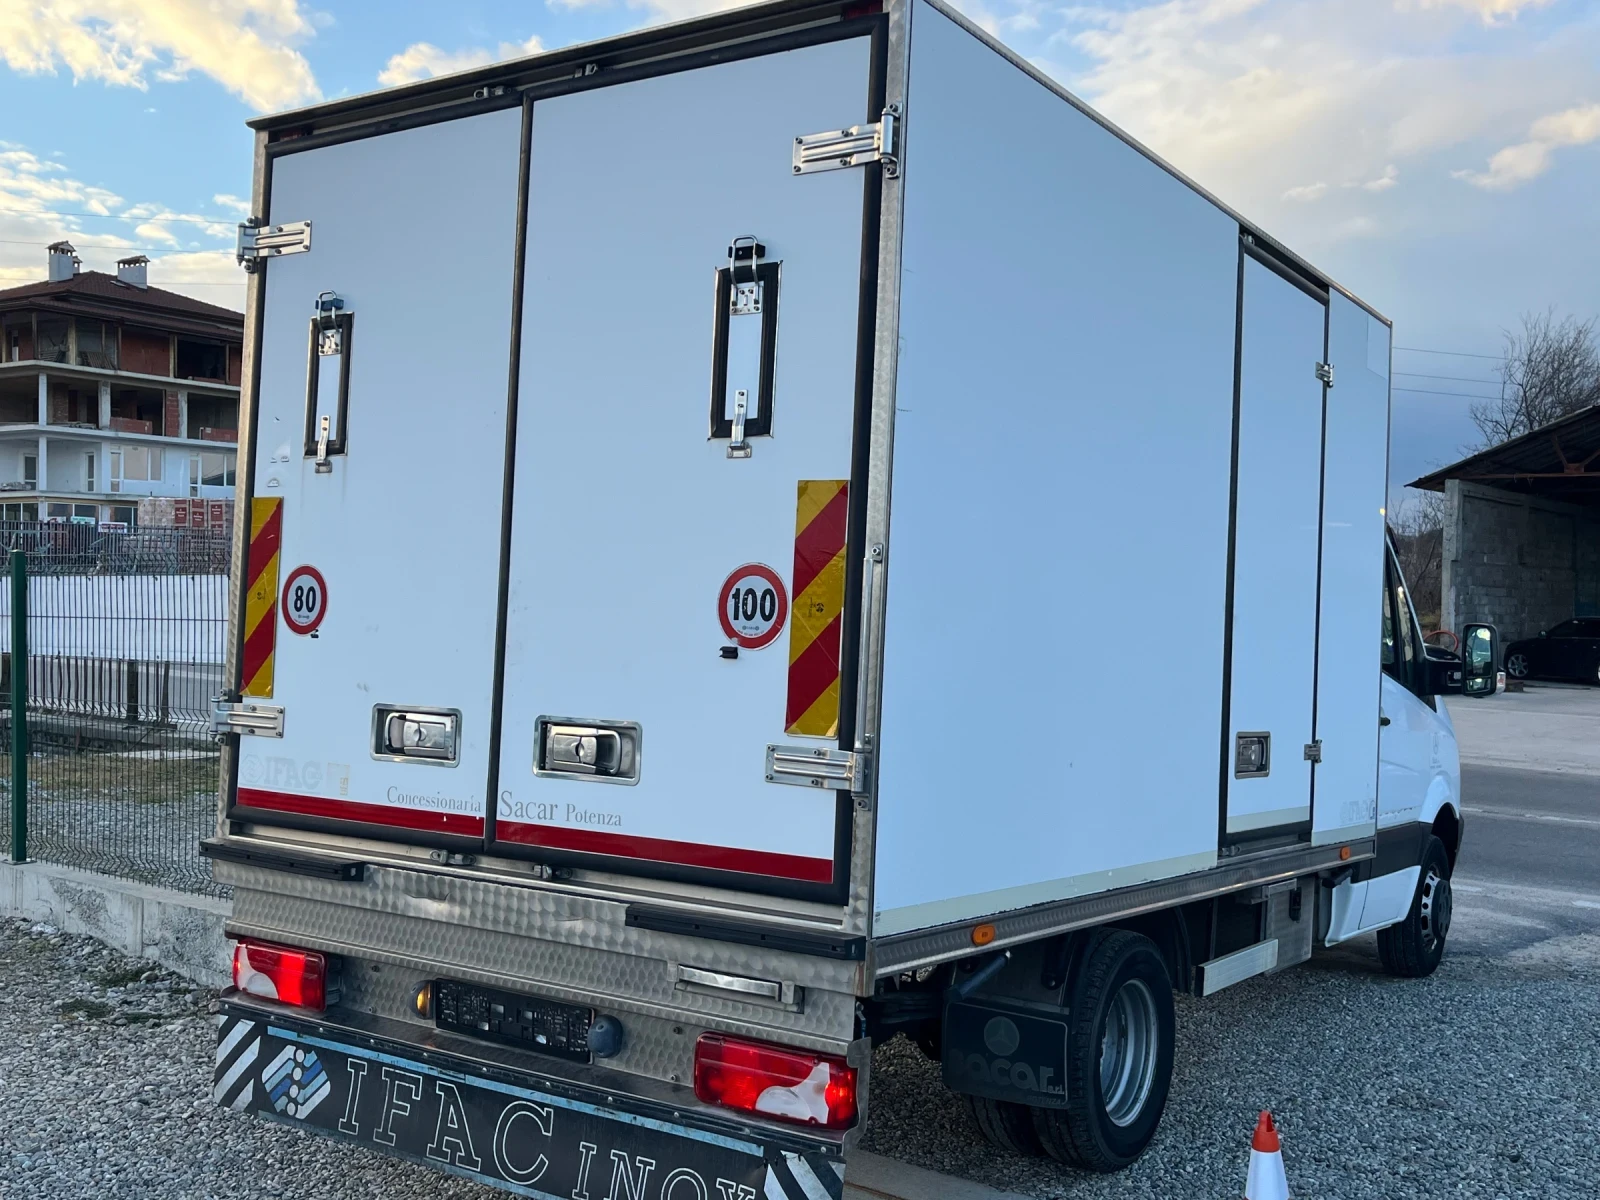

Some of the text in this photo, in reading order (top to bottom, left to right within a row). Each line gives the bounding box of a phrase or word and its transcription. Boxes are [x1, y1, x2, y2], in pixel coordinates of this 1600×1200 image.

[294, 586, 316, 613] 80
[732, 587, 776, 622] 100
[500, 790, 558, 821] Sacar
[565, 803, 622, 827] Potenza
[339, 1058, 553, 1184] IFAC
